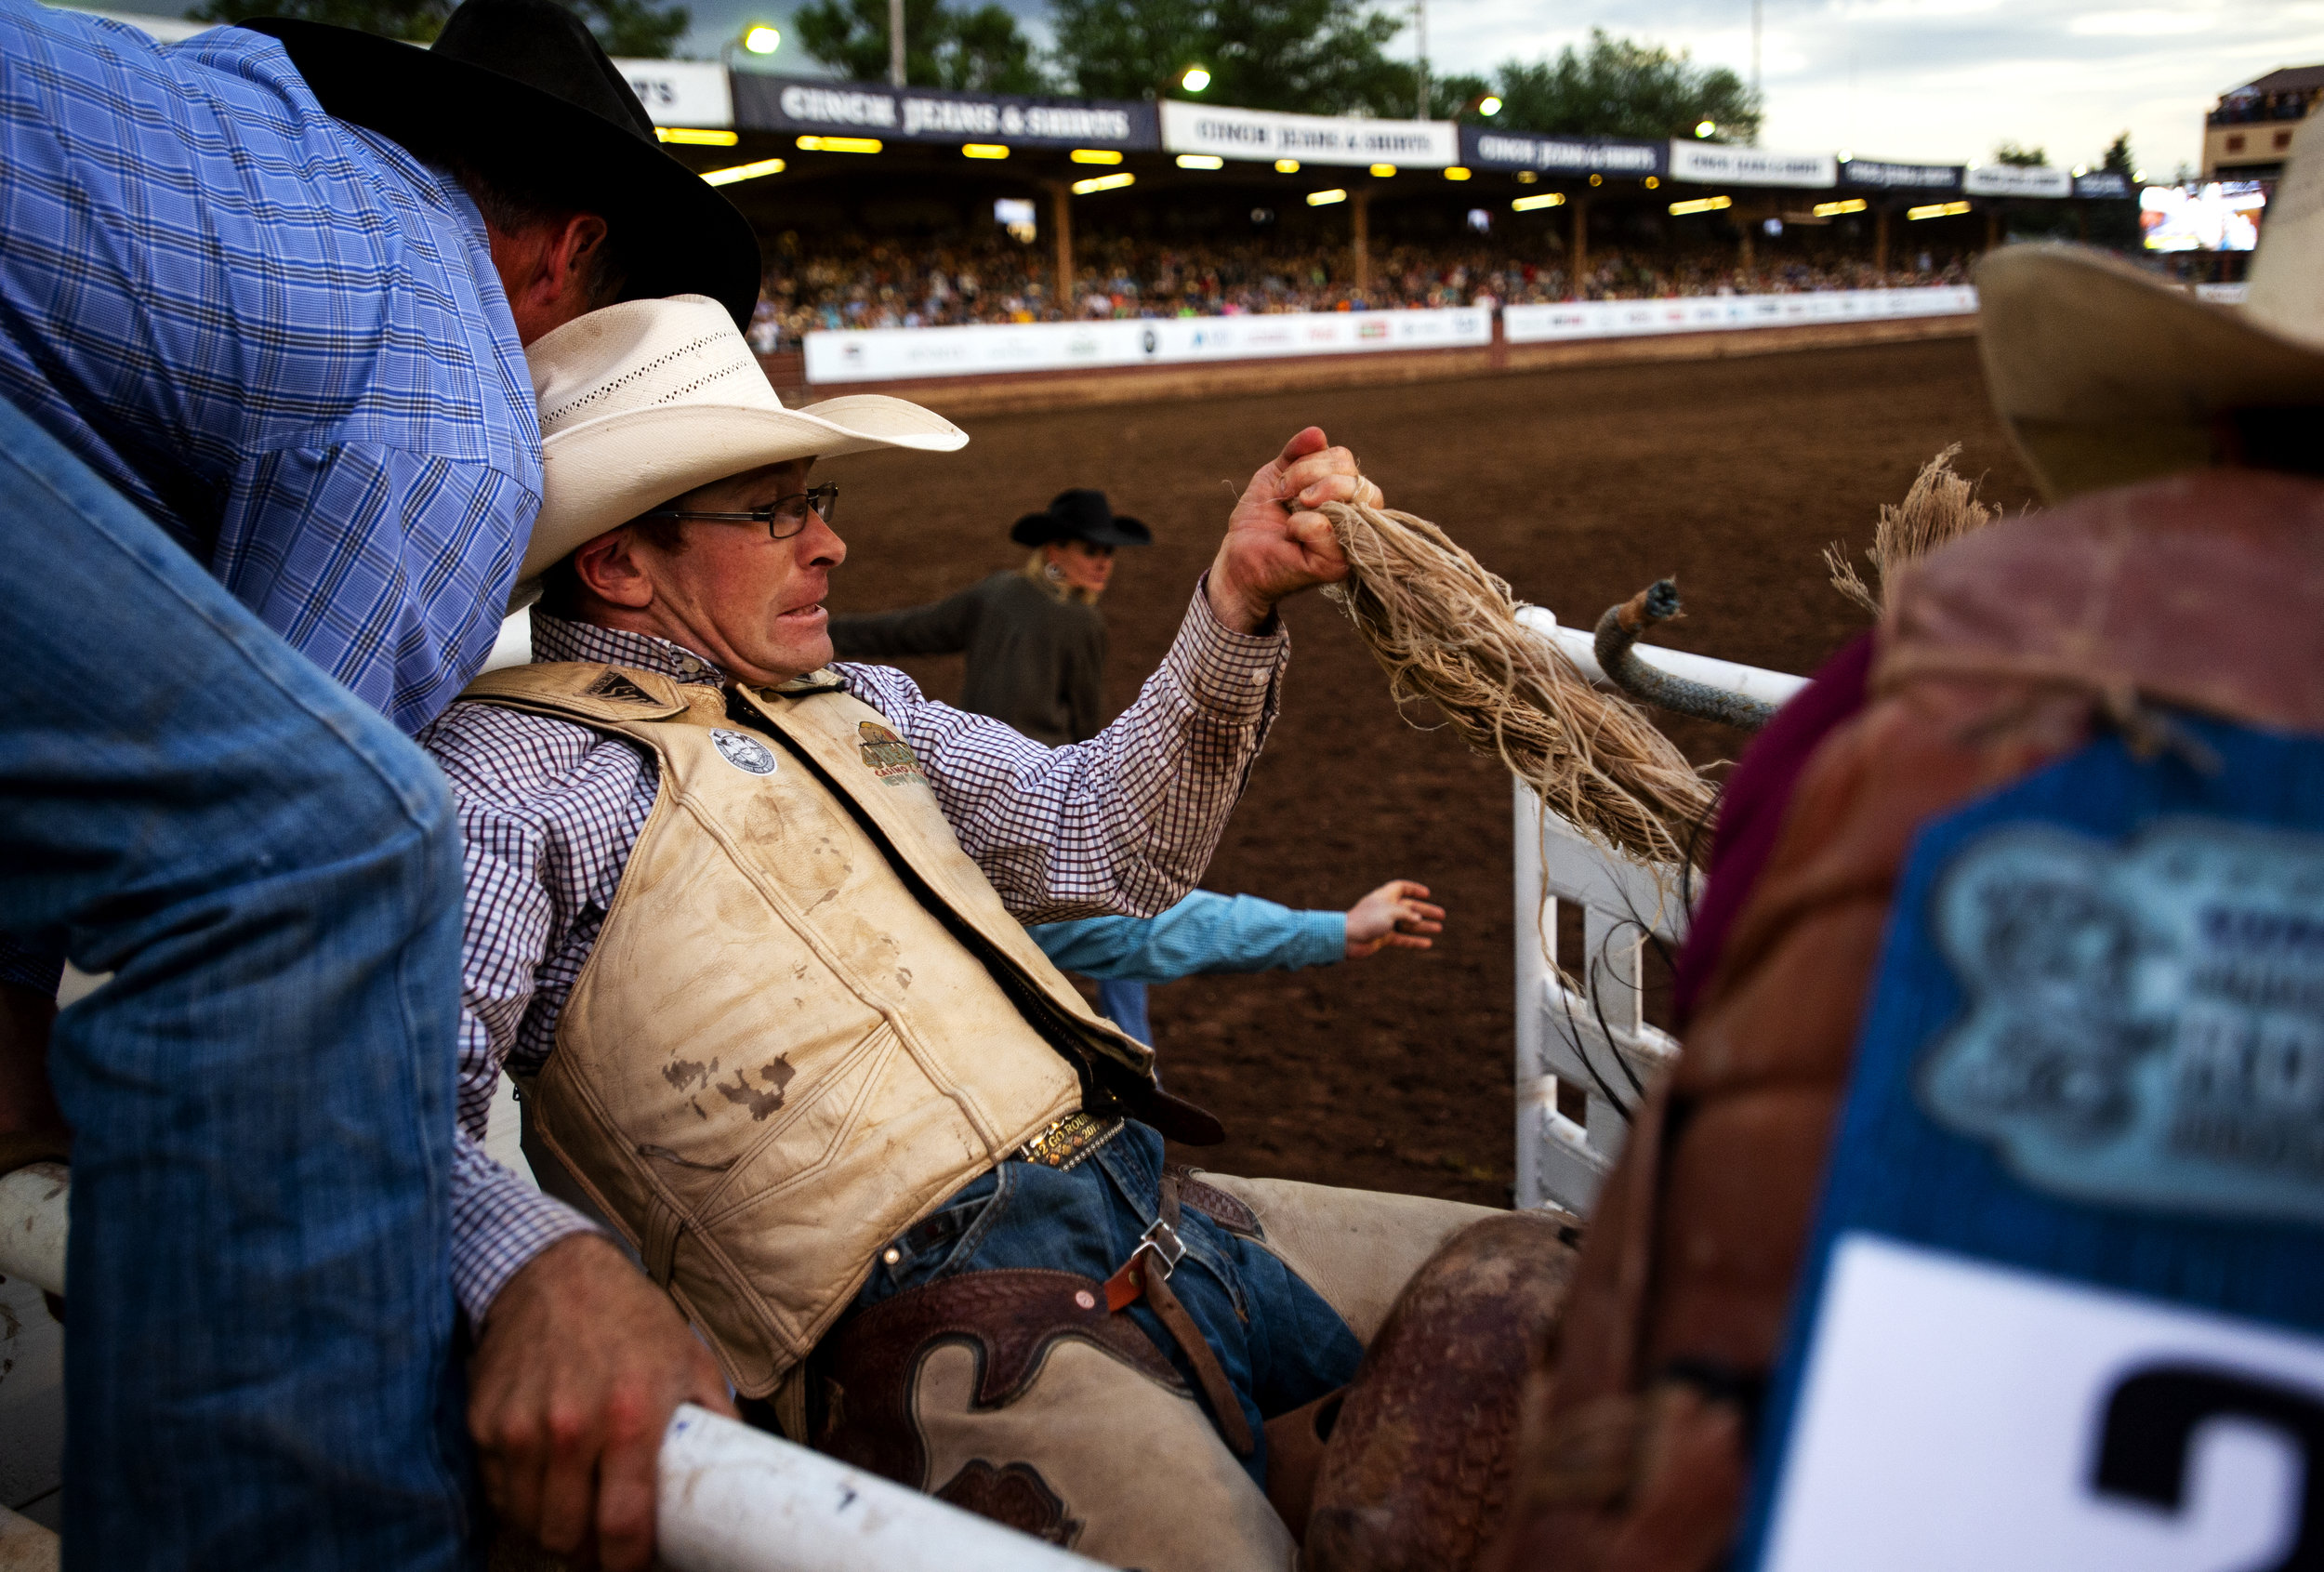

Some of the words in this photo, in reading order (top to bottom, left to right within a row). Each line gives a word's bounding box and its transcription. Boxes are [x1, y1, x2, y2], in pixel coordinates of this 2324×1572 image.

[875, 765, 909, 777] CASINO
[1048, 1129, 1065, 1148] GO
[1063, 1113, 1093, 1135] ROUN
